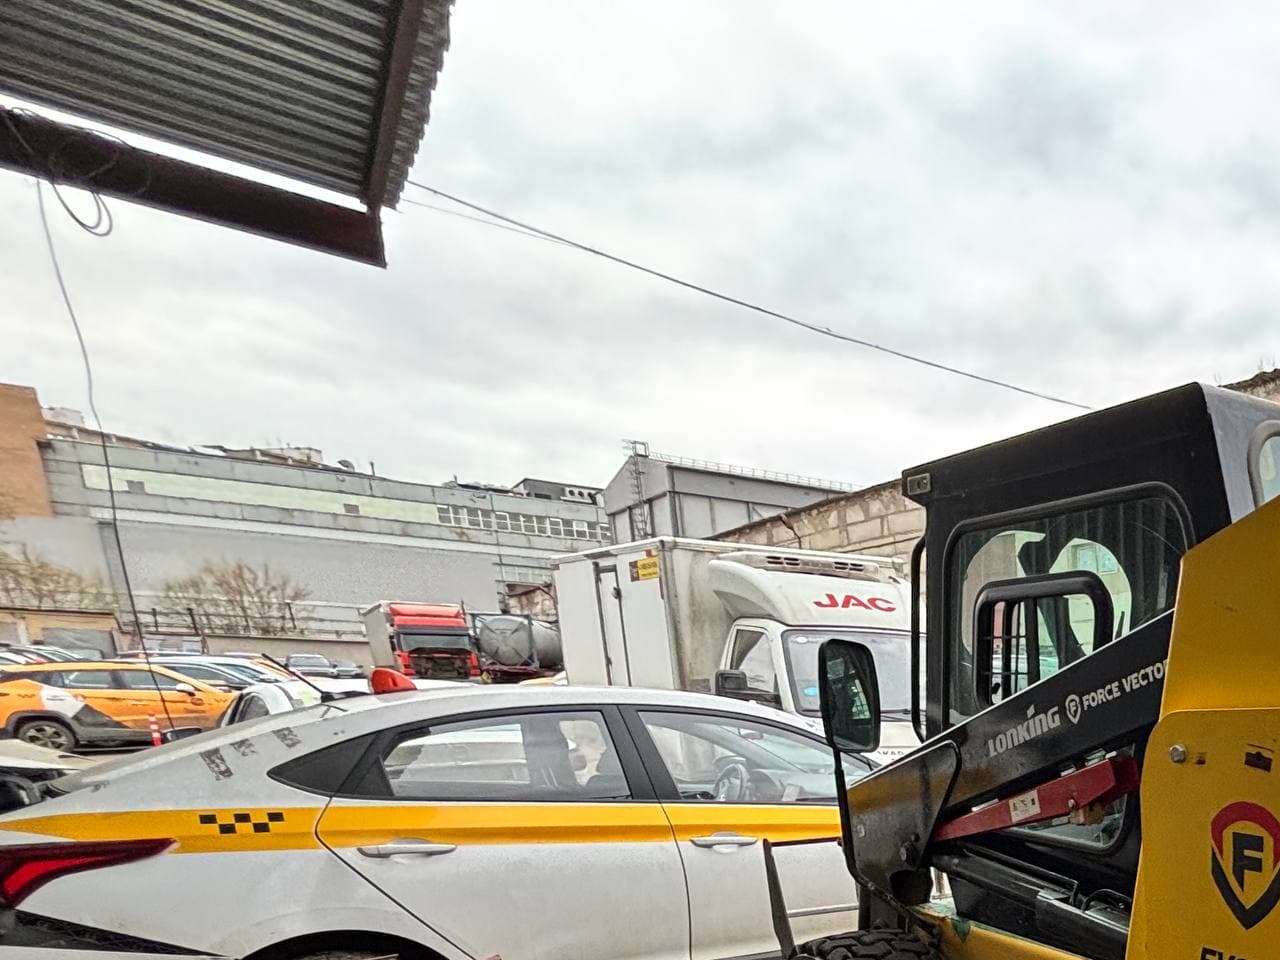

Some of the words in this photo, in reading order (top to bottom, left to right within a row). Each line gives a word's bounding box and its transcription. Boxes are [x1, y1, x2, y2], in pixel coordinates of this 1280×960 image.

[813, 593, 897, 612] JAC
[1081, 681, 1121, 711] FORCE
[1232, 831, 1264, 893] F
